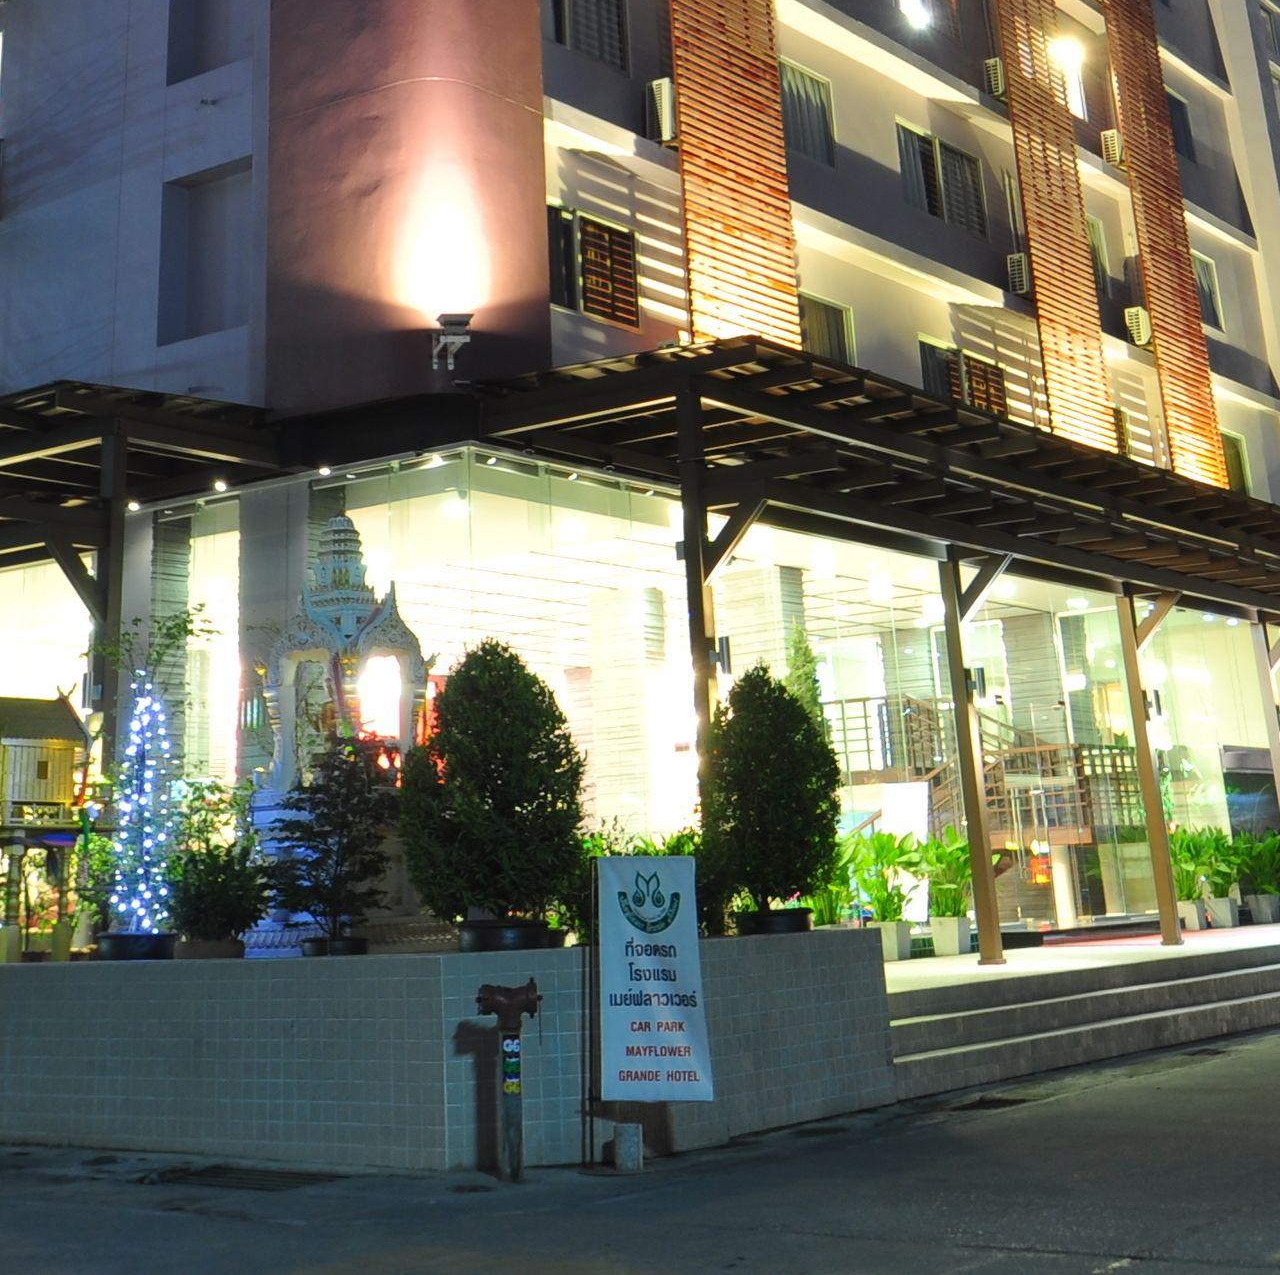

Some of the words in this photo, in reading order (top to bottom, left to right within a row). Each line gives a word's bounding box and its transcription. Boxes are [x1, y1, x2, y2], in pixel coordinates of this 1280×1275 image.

[625, 936, 677, 958] ที่จอดรถ
[628, 961, 677, 982] โรงแรม
[609, 987, 698, 1008] เมย์ฟลาวเวอร์
[630, 1021, 651, 1032] CAR
[656, 1021, 685, 1032] PARK
[625, 1046, 691, 1057] MAYFLOWER
[618, 1070, 661, 1082] GRANDE
[666, 1070, 700, 1082] HOTEL
